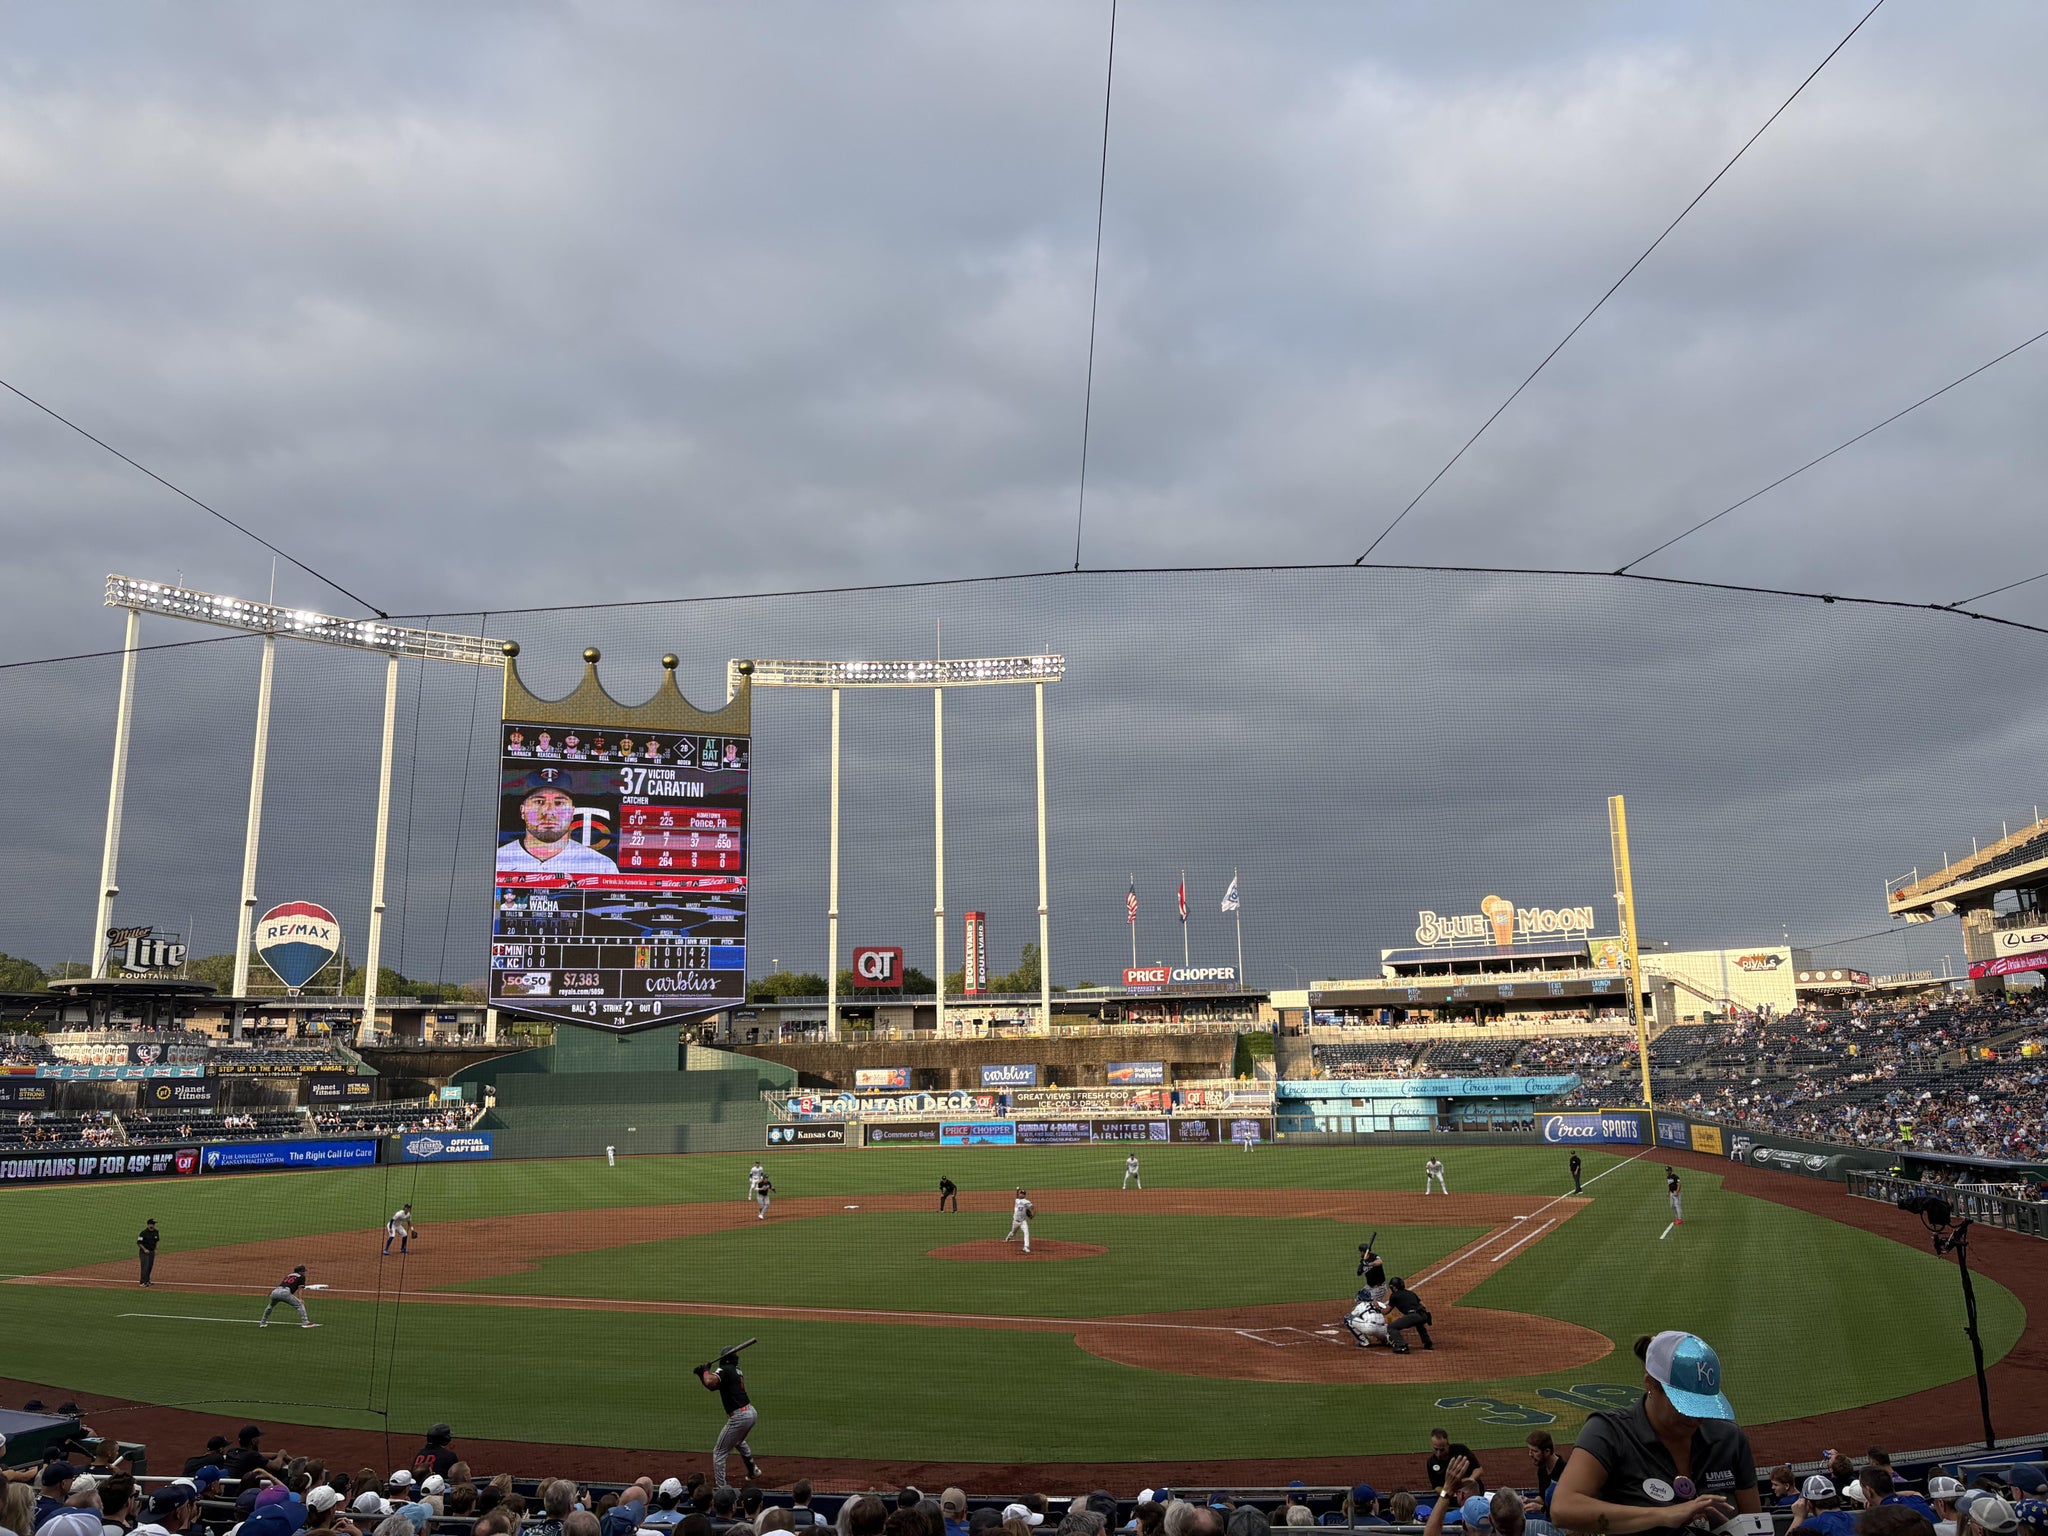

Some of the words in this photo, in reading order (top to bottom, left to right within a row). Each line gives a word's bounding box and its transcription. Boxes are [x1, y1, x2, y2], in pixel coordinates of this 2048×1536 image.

[706, 739, 716, 749] AT
[703, 750, 718, 760] BAT
[648, 769, 675, 780] VICTOR
[620, 768, 647, 794] 37
[648, 780, 704, 797] CARATINI
[623, 796, 648, 805] CATCHER
[660, 817, 673, 826] 225
[690, 818, 715, 829] Ponce,
[717, 819, 727, 828] PR
[630, 837, 645, 846] .227
[664, 838, 668, 846] 7
[690, 838, 699, 847] 37
[715, 840, 731, 848] .650
[632, 856, 641, 865] 60
[658, 857, 672, 866] 264
[692, 858, 696, 867] 9
[720, 859, 725, 868] 0
[530, 901, 558, 911] WACHA
[268, 924, 329, 940] RE/MAX
[1416, 911, 1485, 946] BLUE
[1517, 907, 1594, 933] MOON
[107, 927, 151, 946] Miller
[122, 937, 186, 973] Lite
[505, 946, 522, 955] MIN
[528, 946, 532, 955] 0
[541, 946, 545, 955] 0
[665, 948, 670, 956] 0
[677, 948, 681, 956] 0
[507, 958, 519, 967] KC
[527, 958, 532, 967] 0
[540, 958, 545, 967] 0
[665, 959, 669, 967] 0
[858, 951, 894, 980] QT
[1743, 959, 1776, 969] RIVALS
[564, 973, 599, 987] $7,383
[1128, 970, 1164, 982] PRICE
[1172, 967, 1235, 980] CHOPPER
[507, 977, 523, 985] 50
[532, 977, 546, 985] 50
[646, 972, 721, 992] carbliss
[1627, 978, 1635, 1025] CHIKIN
[572, 1004, 586, 1013] BALL
[589, 1001, 596, 1016] 3
[603, 1005, 622, 1013] STRIKE
[625, 1001, 632, 1016] 2
[654, 1001, 661, 1015] 0
[984, 1065, 1032, 1083] carbliss
[175, 1086, 205, 1094] planet
[1401, 1081, 1427, 1095] Circa
[1463, 1080, 1489, 1094] Circa
[1525, 1078, 1552, 1093] Circa
[179, 1091, 210, 1100] fitness
[1188, 1093, 1200, 1103] QT
[822, 1098, 918, 1113] FOUNTAIN
[923, 1097, 972, 1110] DECK
[978, 1098, 991, 1107] QT
[828, 1130, 843, 1140] City
[884, 1130, 917, 1138] Commerce
[945, 1127, 968, 1135] PRICE
[972, 1126, 1010, 1134] CHOPPER
[1545, 1116, 1597, 1142] Circa
[1602, 1120, 1637, 1138] SPORTS
[153, 1154, 160, 1162] IN
[161, 1154, 173, 1162] APP
[290, 1152, 303, 1161] The
[306, 1152, 325, 1162] Right
[327, 1150, 342, 1158] Call
[343, 1149, 353, 1158] for
[355, 1149, 372, 1157] Care
[0, 1158, 76, 1178] FOUNTAINS
[78, 1157, 98, 1175] UP
[99, 1156, 125, 1174] FOR
[127, 1155, 150, 1172] 49¢
[152, 1163, 167, 1171] ONLY
[178, 1157, 193, 1169] QT
[1696, 1361, 1715, 1386] KC
[1705, 1470, 1732, 1480] UMB
